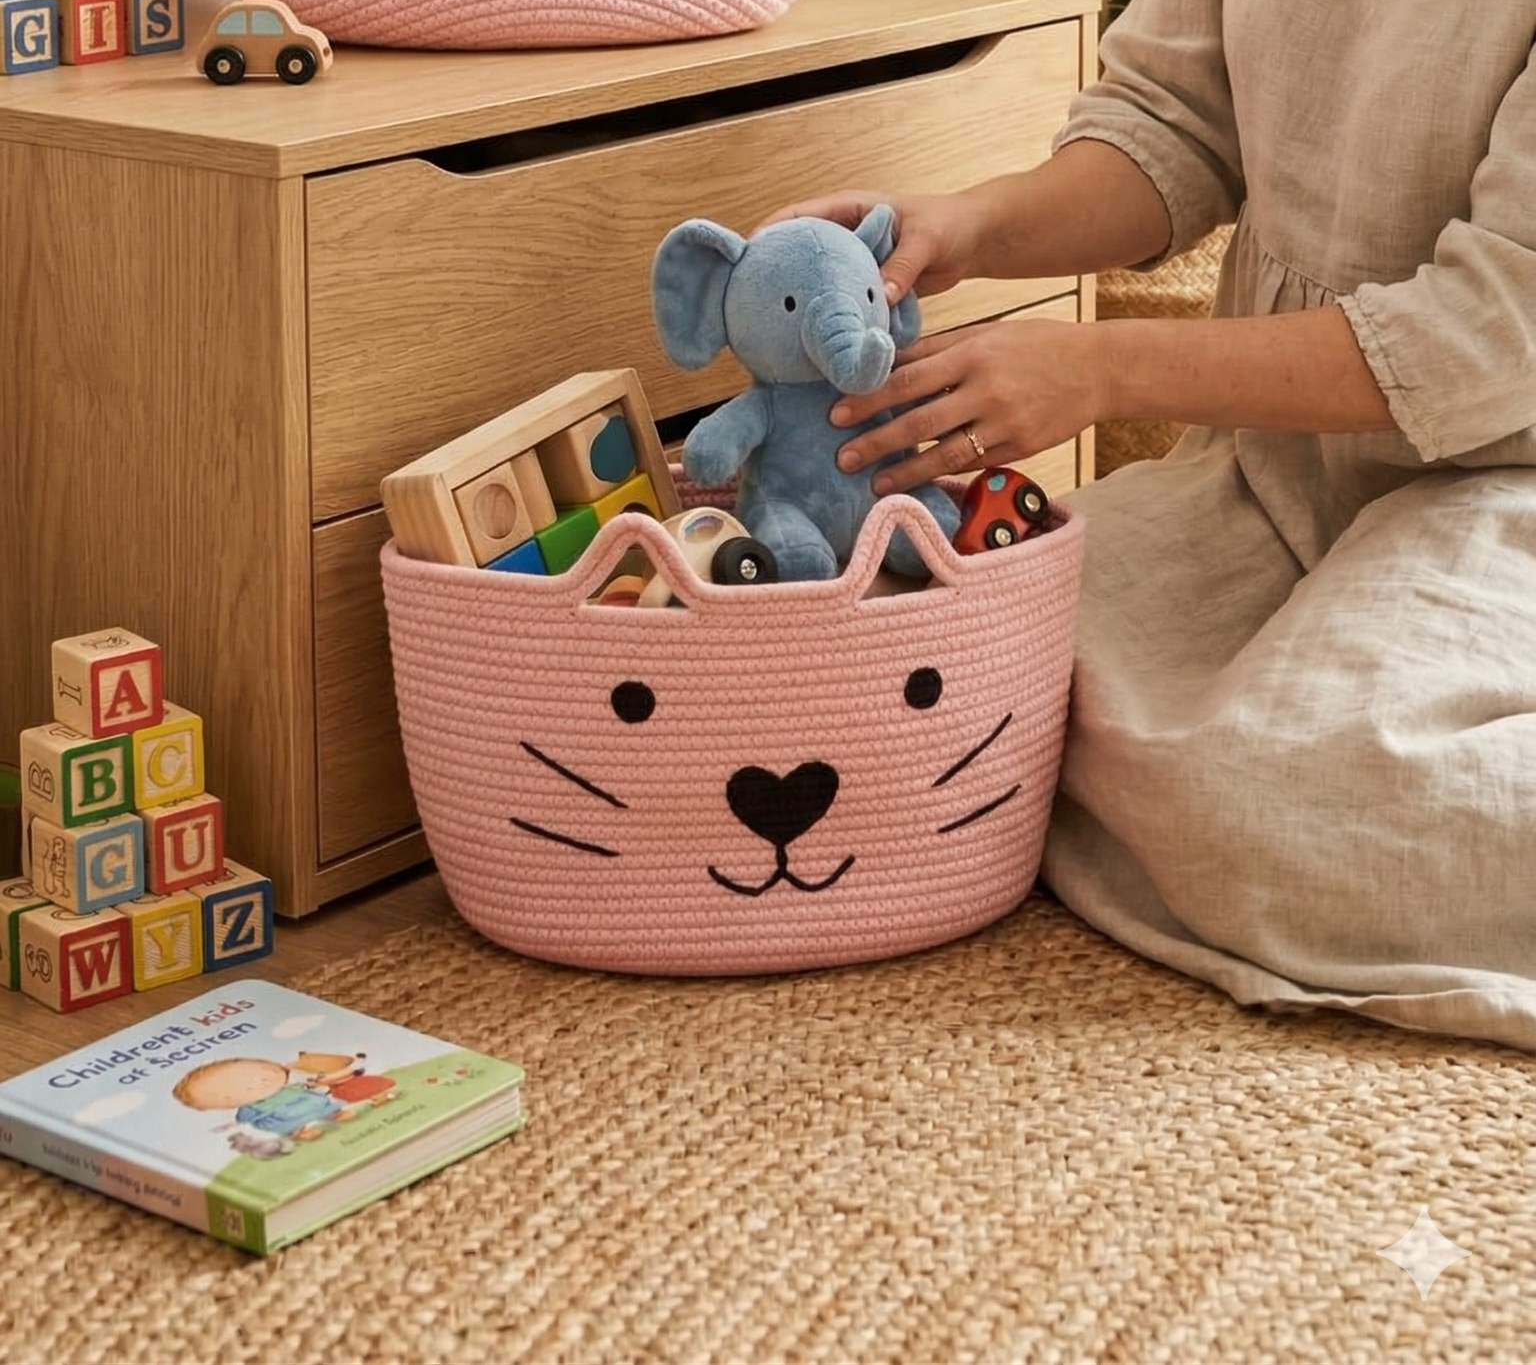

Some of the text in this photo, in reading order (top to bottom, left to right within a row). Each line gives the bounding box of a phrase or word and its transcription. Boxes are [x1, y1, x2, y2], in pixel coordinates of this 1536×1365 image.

[14, 14, 47, 57] G
[88, 5, 109, 49] I
[104, 669, 147, 721] A
[78, 737, 187, 806] B C
[90, 821, 209, 889] G U
[69, 938, 119, 991] W
[146, 919, 187, 969] Y
[221, 900, 255, 952] Z
